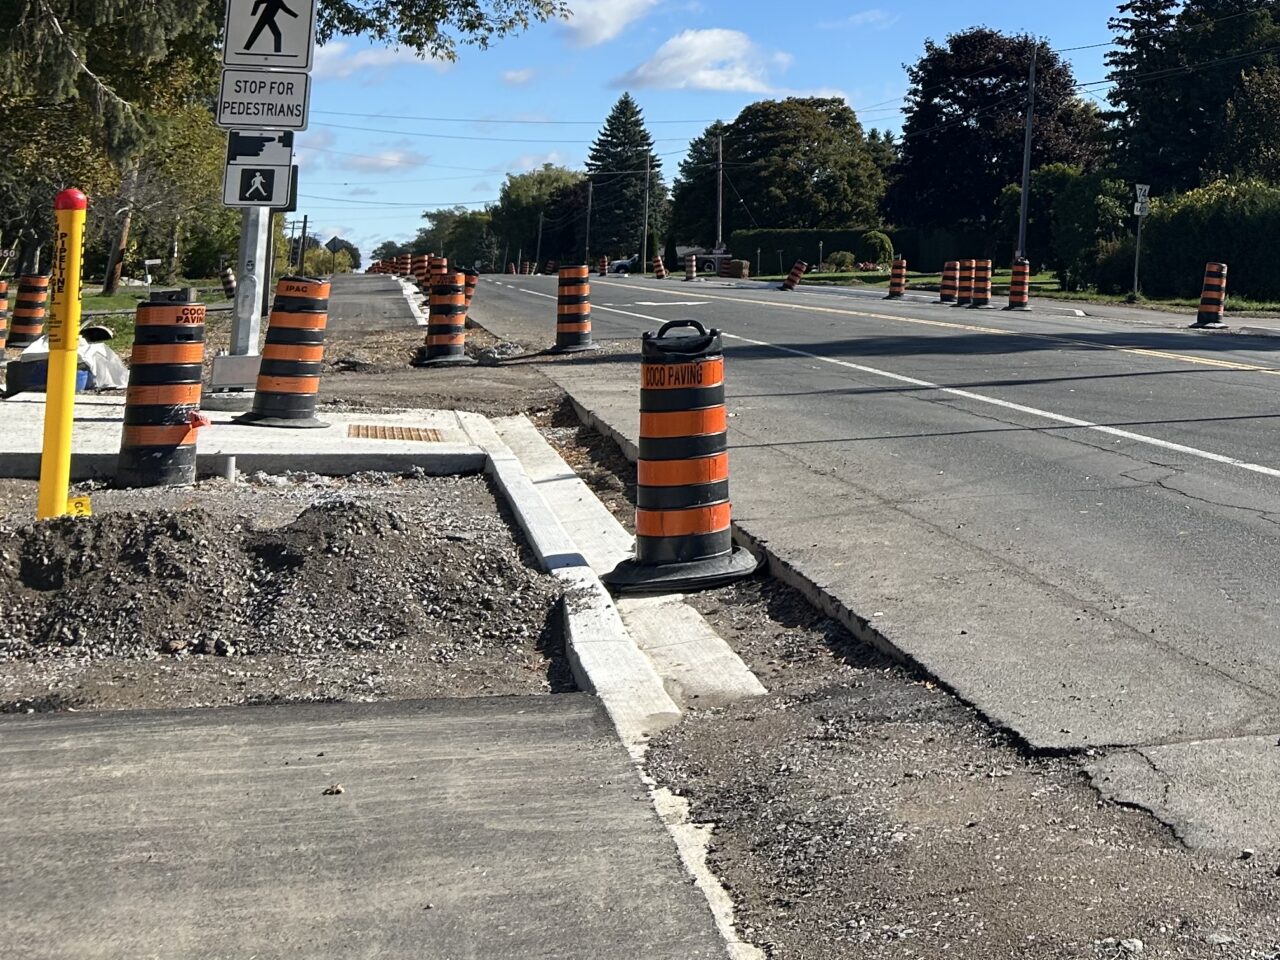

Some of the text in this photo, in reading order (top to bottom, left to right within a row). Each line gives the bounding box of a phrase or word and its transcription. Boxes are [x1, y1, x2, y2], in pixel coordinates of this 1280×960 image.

[234, 80, 294, 96] STOP FOR
[222, 101, 302, 118] PEDESTRIANS
[57, 232, 67, 293] PIPELINE
[646, 364, 703, 387] COCO PAVING
